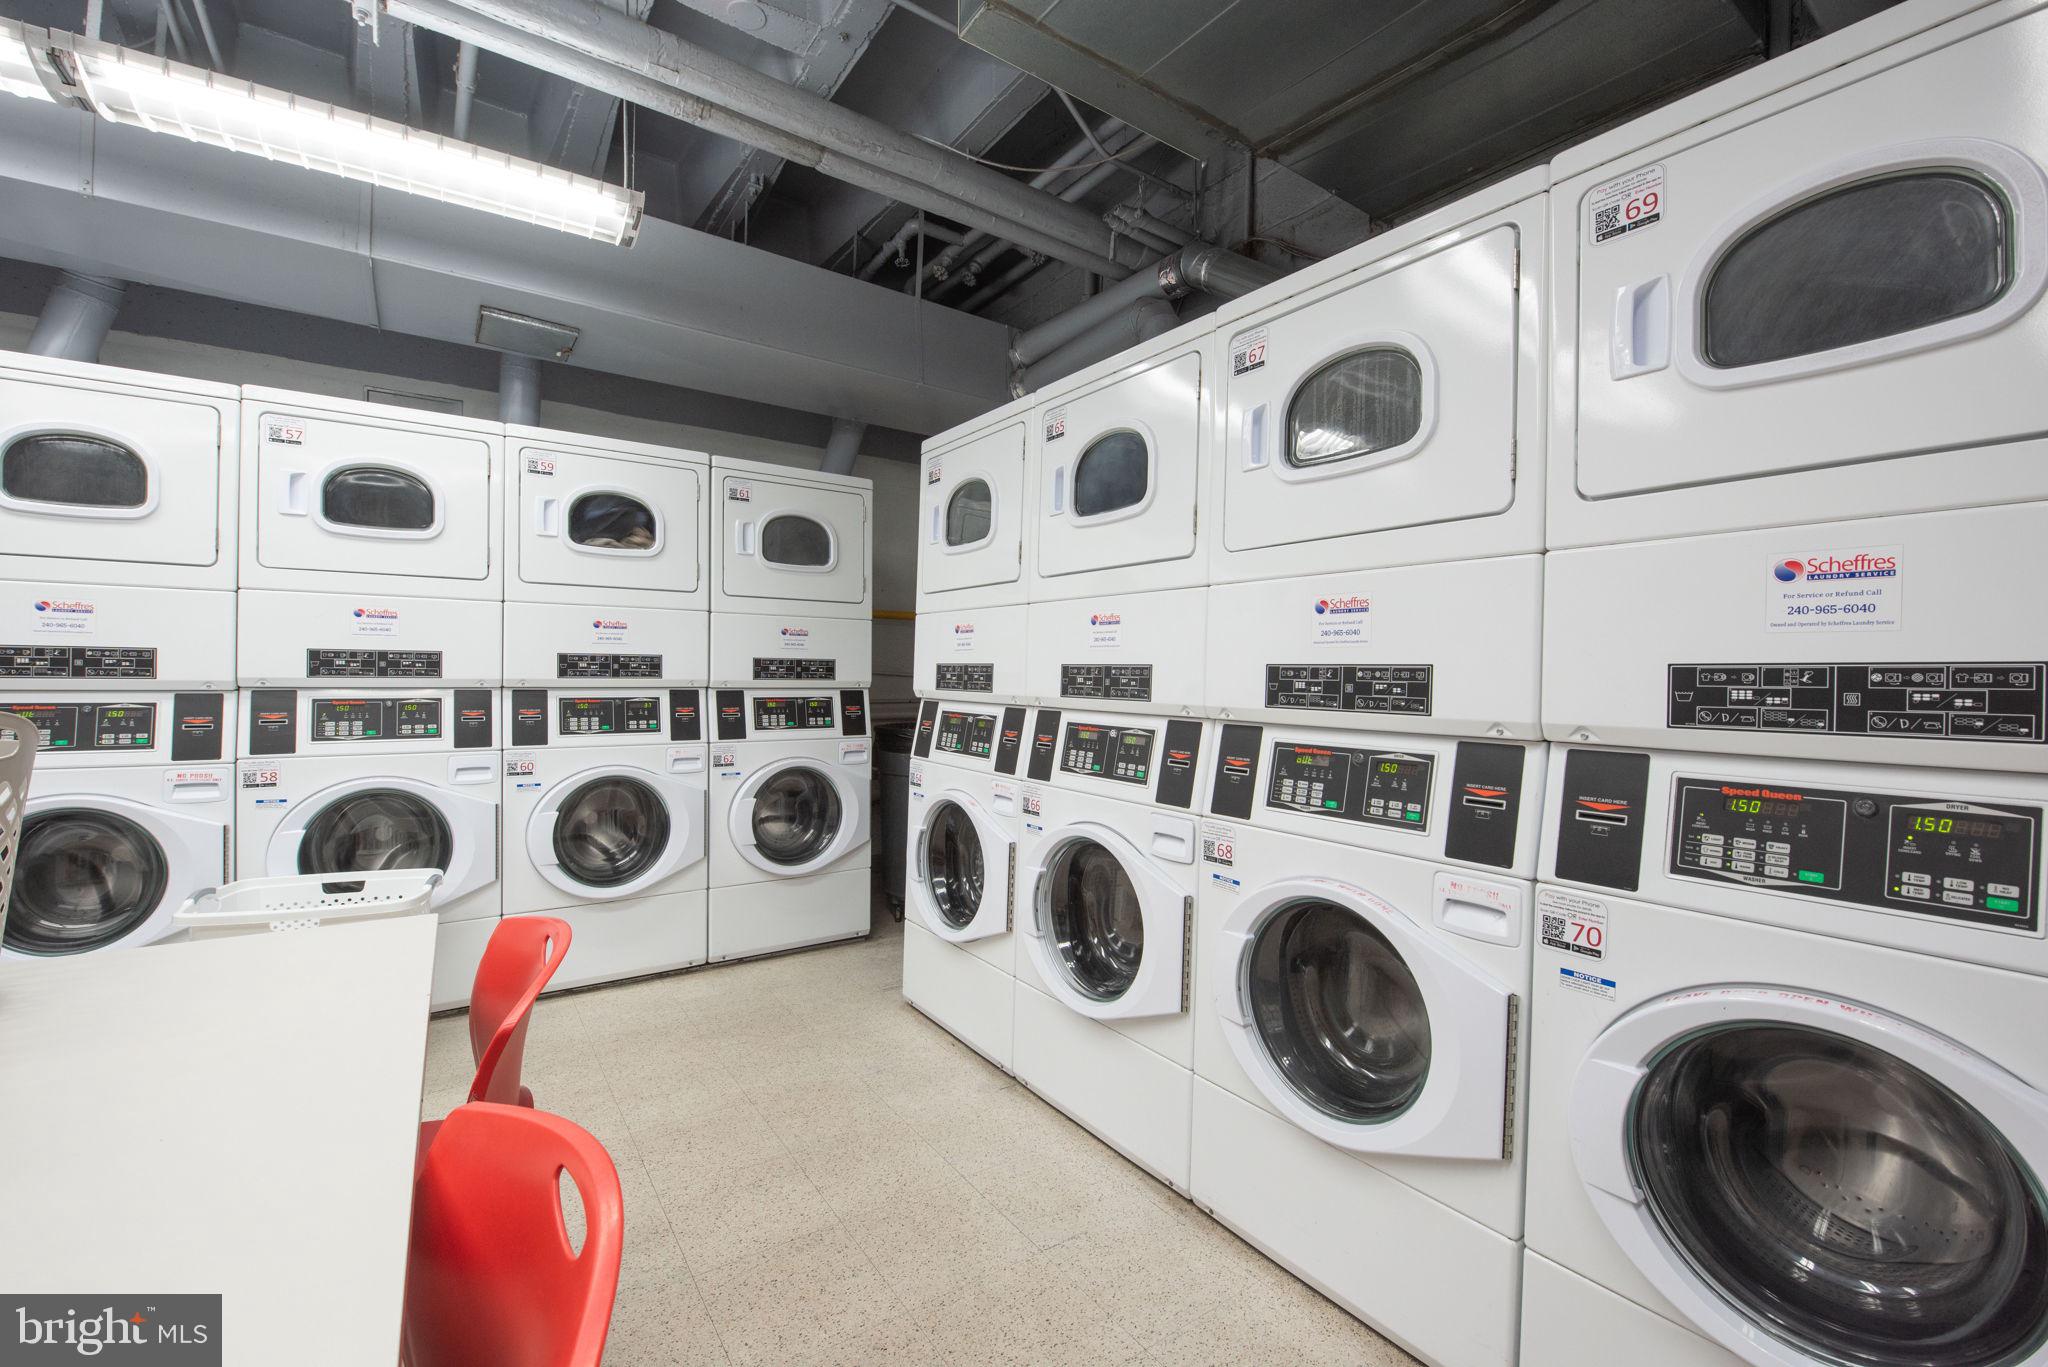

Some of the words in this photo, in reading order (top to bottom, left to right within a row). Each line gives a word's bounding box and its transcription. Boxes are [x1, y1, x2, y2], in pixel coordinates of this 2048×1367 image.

[1625, 192, 1659, 220] 69
[1249, 345, 1265, 363] 67
[1055, 420, 1065, 434] 65
[286, 429, 303, 440] 57
[541, 461, 554, 471] 59
[1807, 554, 1896, 573] Scheffres
[1855, 570, 1895, 578] SERVICE
[1835, 590, 1864, 598] Refund
[52, 601, 94, 610] Scheffres
[1330, 596, 1370, 609] Scheffres
[1787, 603, 1876, 616] 240-965-6040
[1320, 629, 1361, 637] 240-965-6040
[723, 755, 735, 763] 62
[520, 762, 534, 771] 60
[260, 771, 278, 783] 58
[1720, 786, 1760, 798] Speed
[1761, 789, 1802, 801] Queen
[1031, 799, 1041, 812] 66
[1731, 799, 1761, 814] 1.50
[1946, 803, 1970, 811] DRYER
[1915, 816, 1953, 833] 1.50
[1217, 843, 1233, 860] 68
[1743, 876, 1766, 884] WASHER
[1581, 899, 1601, 908] Phone
[1571, 921, 1602, 947] 70
[1573, 970, 1602, 984] NOTICE
